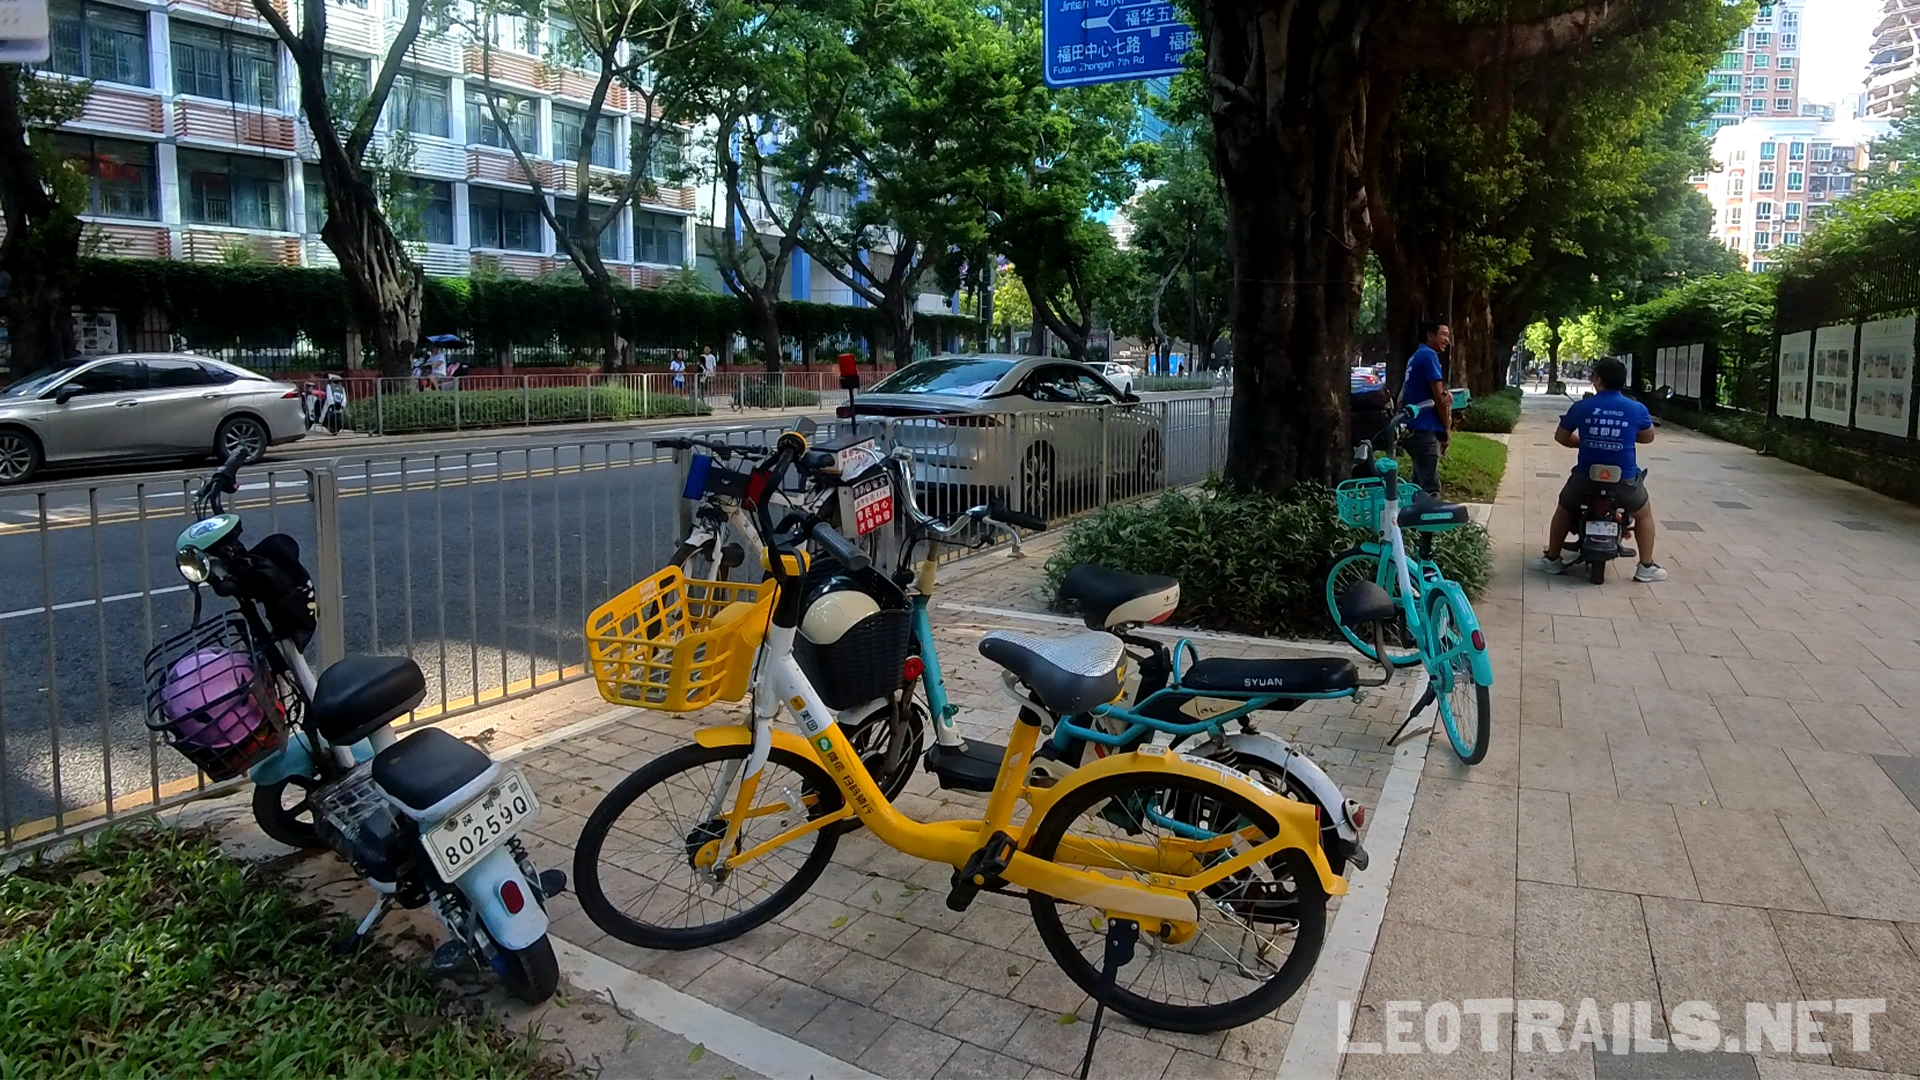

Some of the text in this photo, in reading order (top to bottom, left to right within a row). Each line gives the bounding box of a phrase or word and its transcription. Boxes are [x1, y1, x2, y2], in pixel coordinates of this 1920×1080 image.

[1057, 35, 1141, 64] 福田中心七路
[1053, 54, 1145, 75] Futian Zhongxin 7th Rd
[1244, 677, 1283, 687] SYUAN
[800, 709, 819, 732] 美团
[827, 751, 875, 816] 微信 扫码骑行
